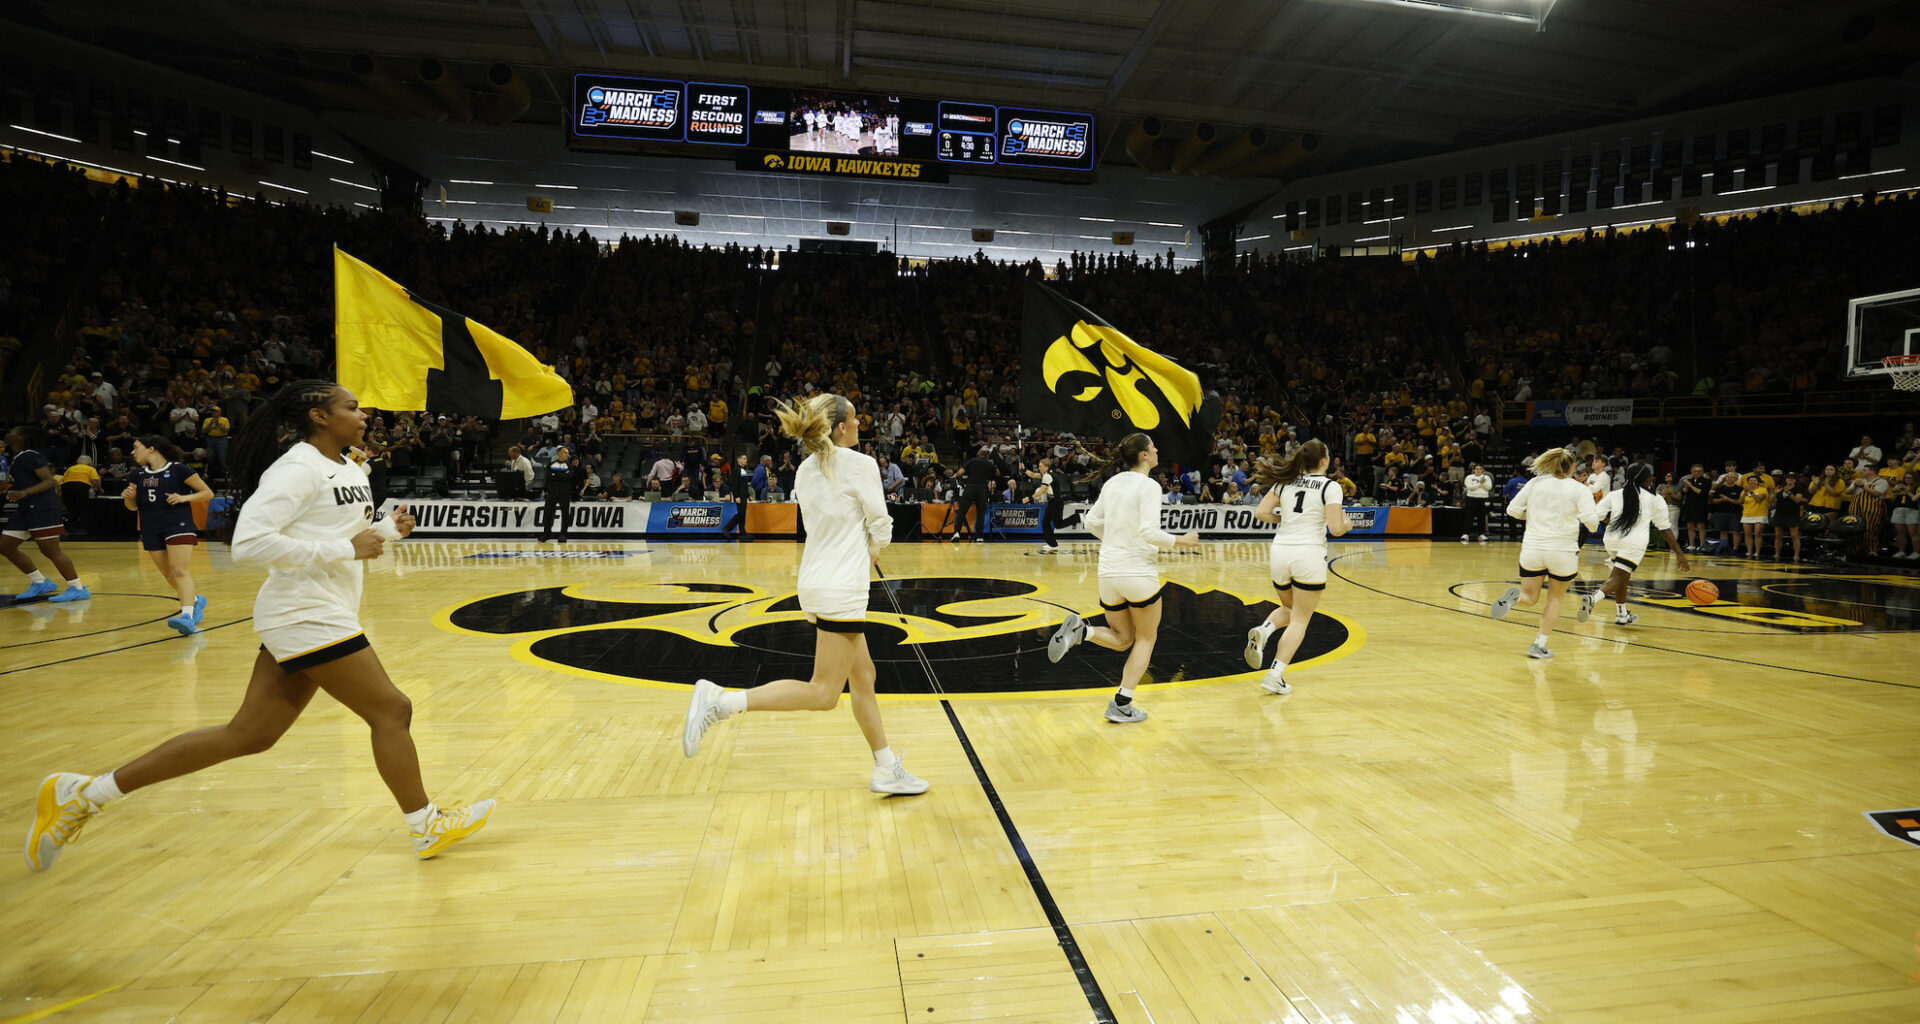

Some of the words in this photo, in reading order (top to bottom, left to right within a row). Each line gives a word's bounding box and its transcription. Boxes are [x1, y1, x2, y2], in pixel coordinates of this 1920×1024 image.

[604, 91, 653, 107] MARCH
[698, 94, 738, 106] FIRST
[609, 106, 675, 123] MADNESS
[691, 110, 743, 123] SECOND
[690, 121, 743, 134] ROUNDS
[1023, 122, 1066, 138] MARCH
[1027, 137, 1084, 153] MADNESS
[788, 155, 831, 172] IOWA
[836, 158, 921, 178] HAWKEYES
[1583, 413, 1619, 421] ROUNDS
[148, 489, 157, 502] 5
[1293, 490, 1306, 513] 1
[680, 508, 708, 516] MARCH
[1160, 509, 1218, 529] ECOND
[683, 516, 721, 524] MADNESS
